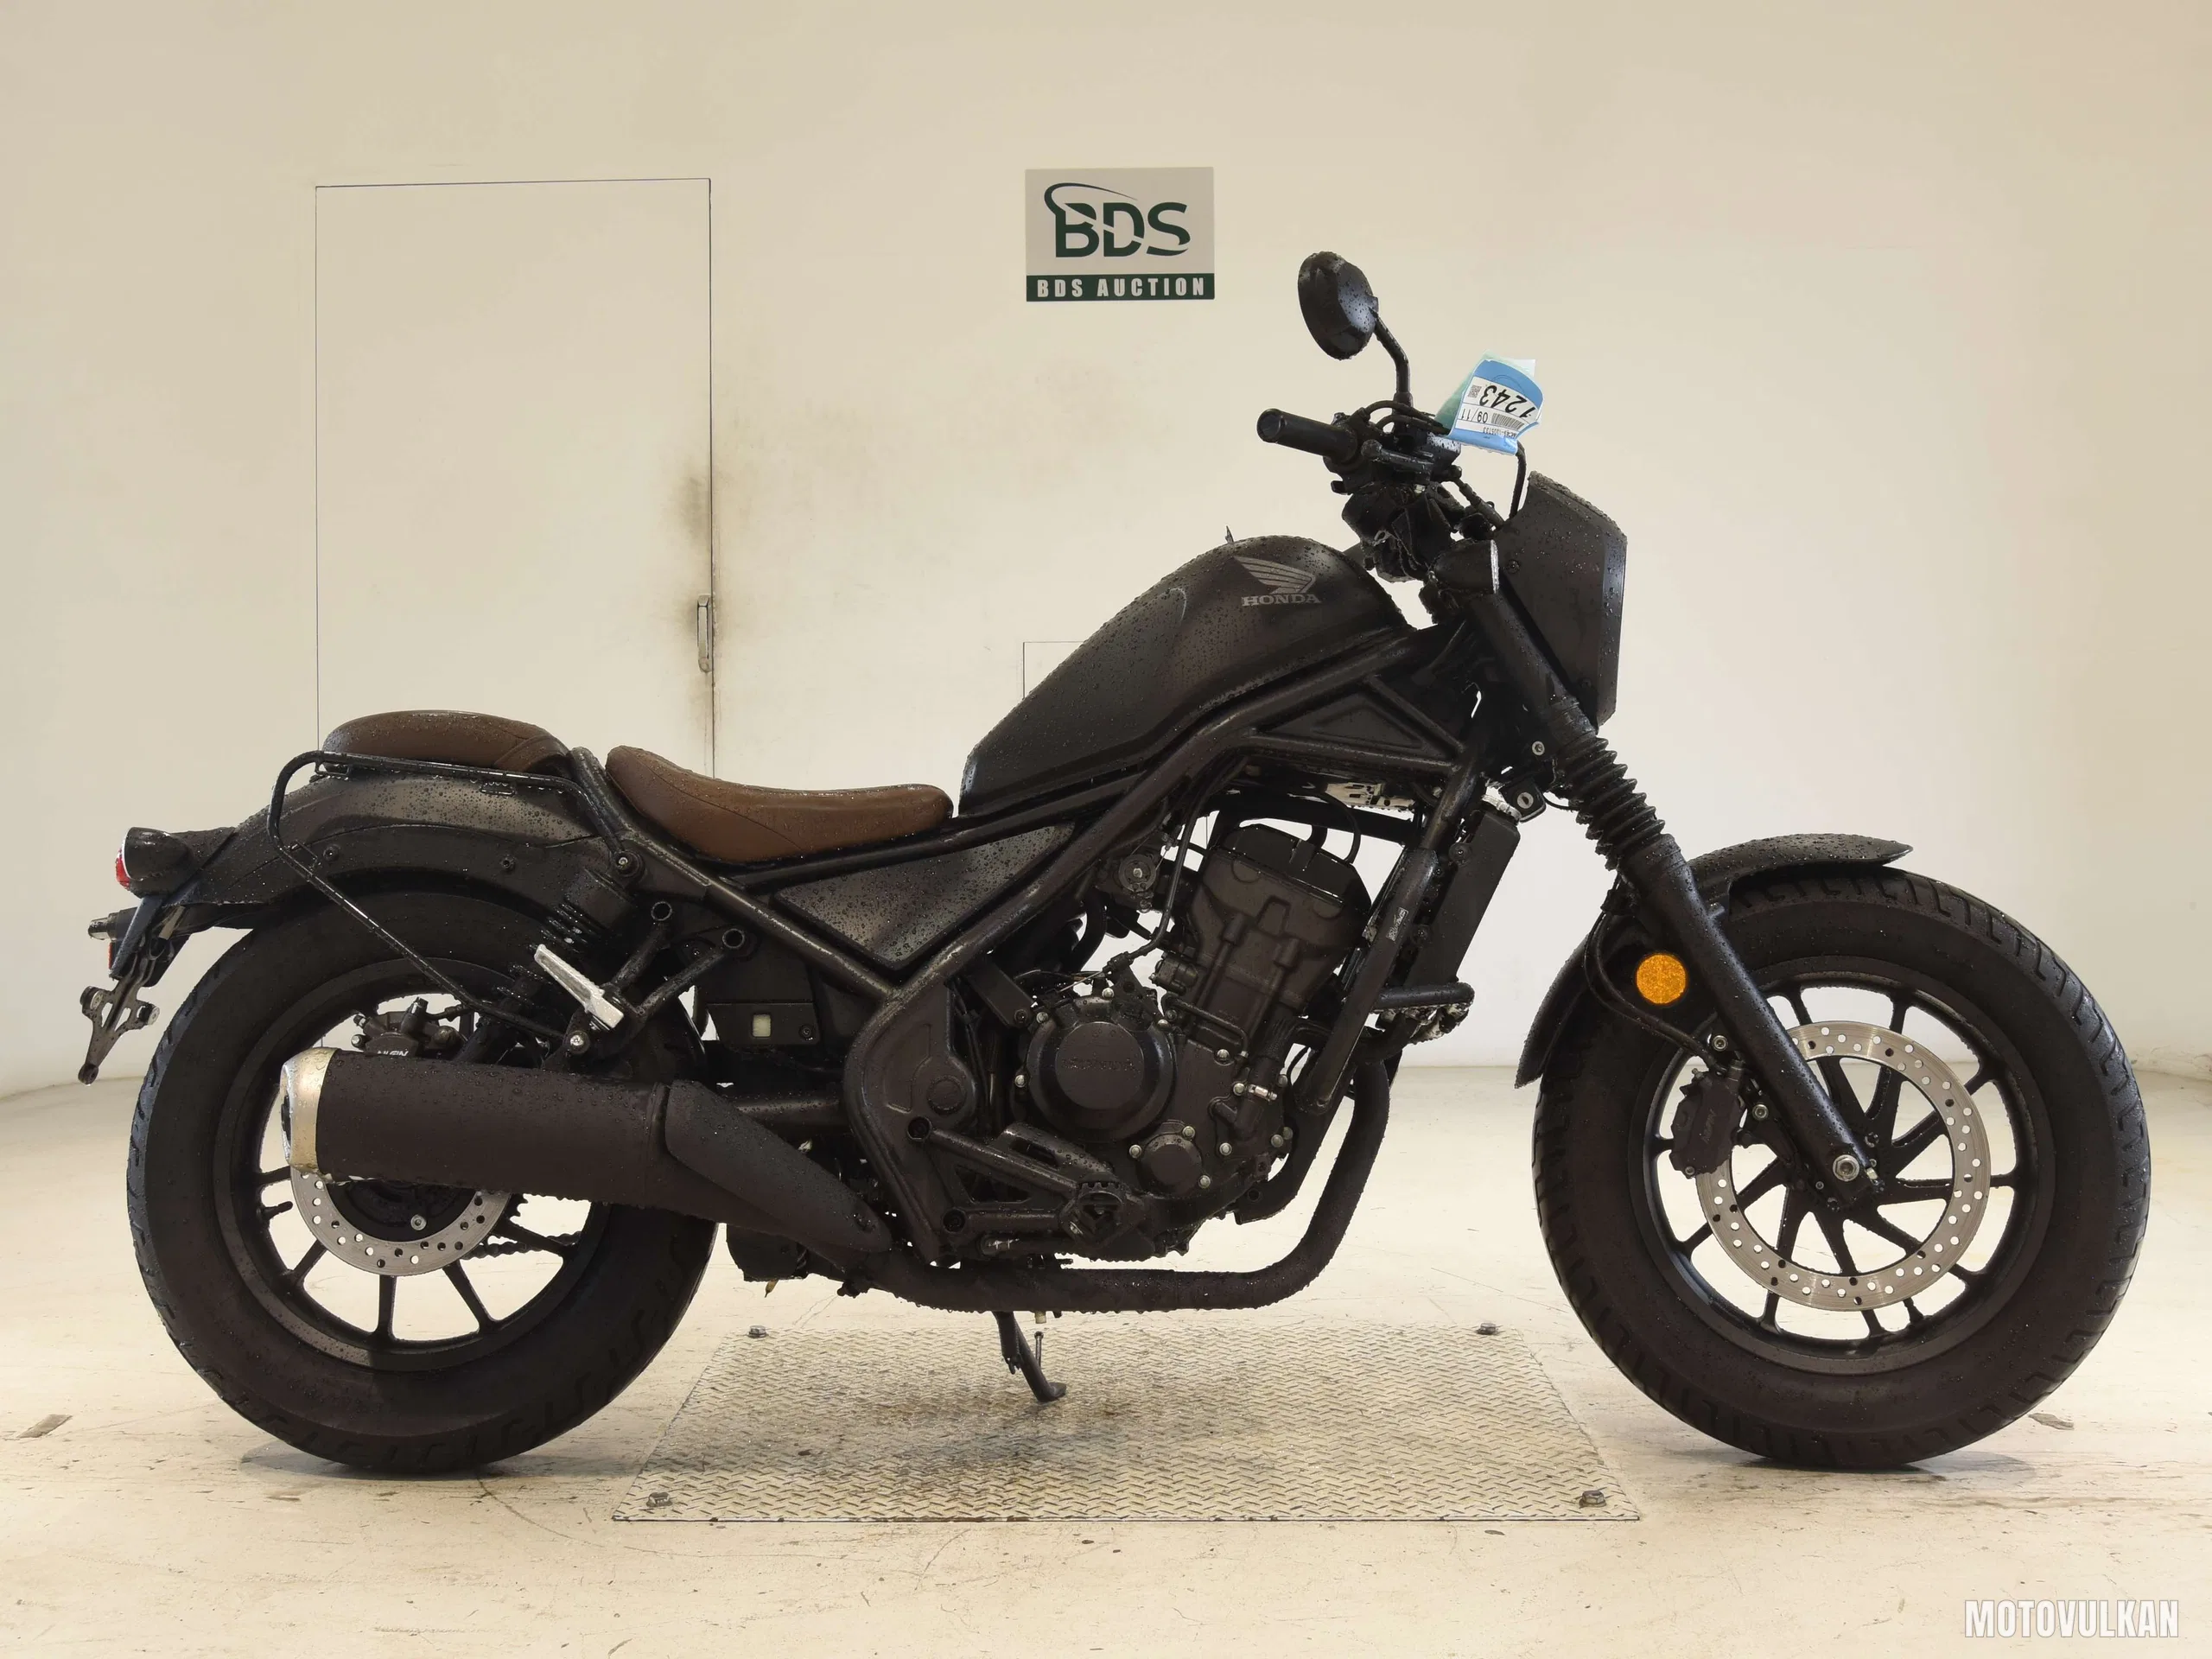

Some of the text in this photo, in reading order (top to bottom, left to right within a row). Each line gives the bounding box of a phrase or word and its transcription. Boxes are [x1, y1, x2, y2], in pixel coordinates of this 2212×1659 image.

[1044, 182, 1191, 257] BDS
[1037, 277, 1204, 297] BDS AUCTION
[1479, 385, 1535, 418] 1243
[1461, 408, 1488, 424] 09/11
[1242, 594, 1321, 607] HONDA
